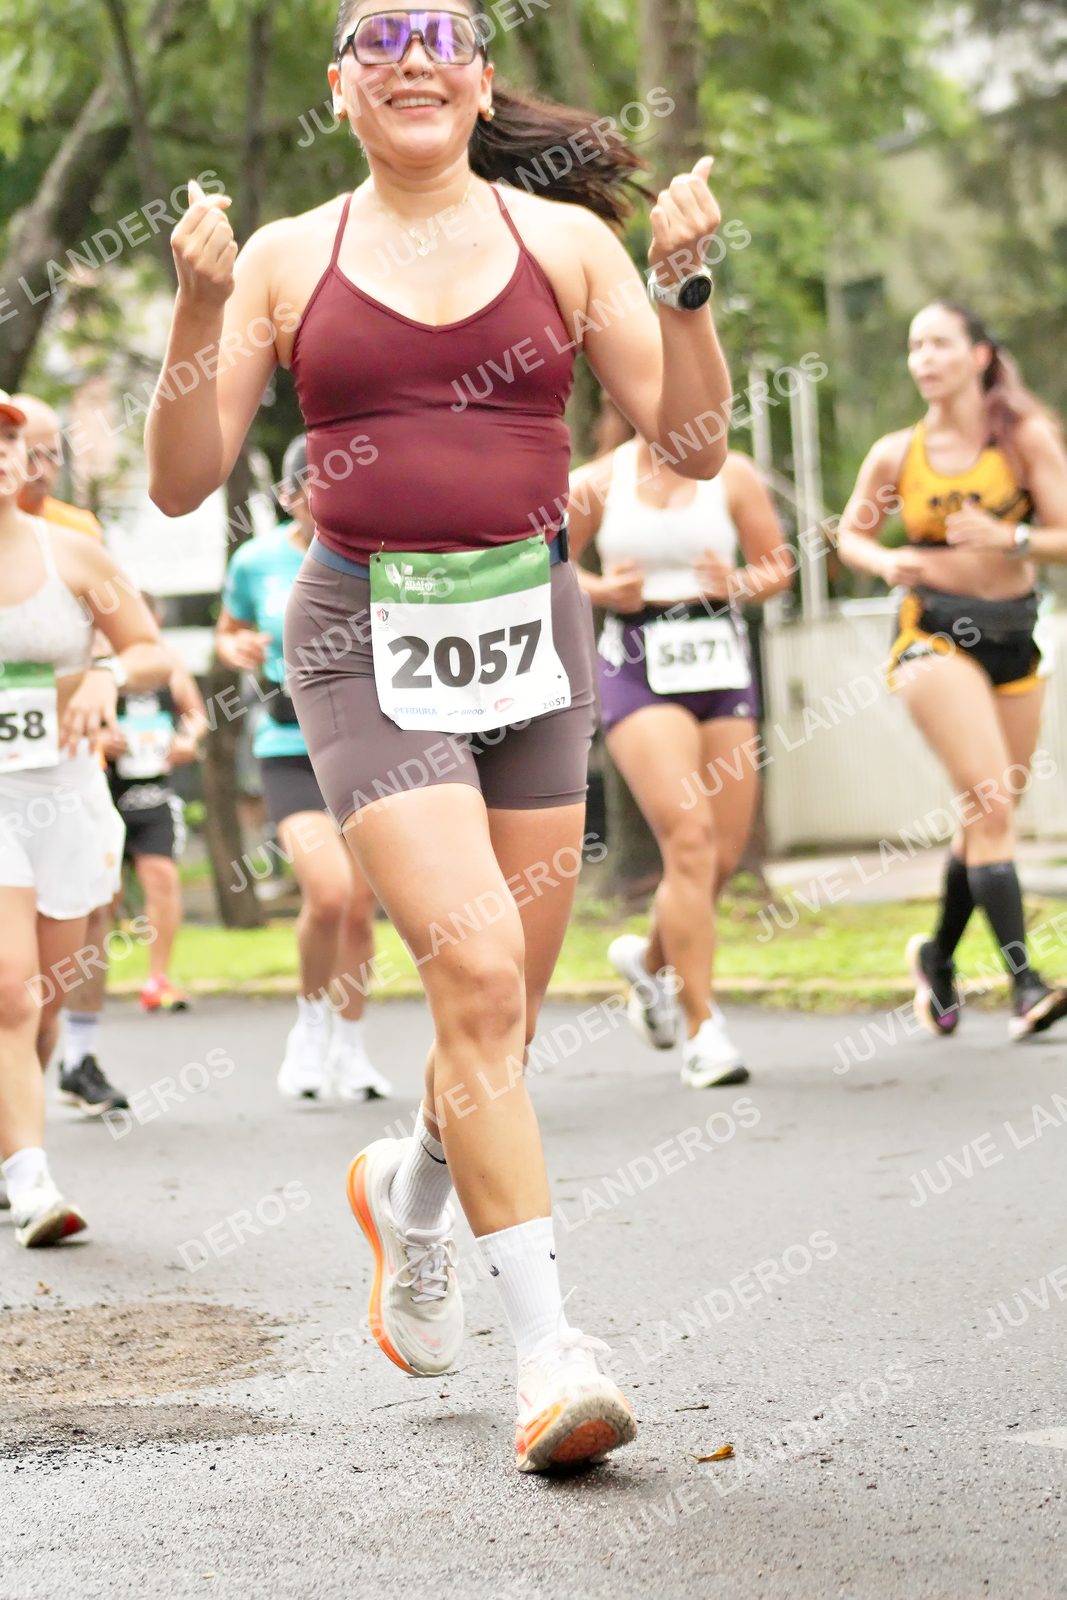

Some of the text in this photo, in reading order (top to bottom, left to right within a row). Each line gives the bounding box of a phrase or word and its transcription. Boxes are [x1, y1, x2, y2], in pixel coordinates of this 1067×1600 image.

[387, 618, 542, 689] 2057
[658, 640, 732, 668] 5871
[543, 696, 566, 710] 2057
